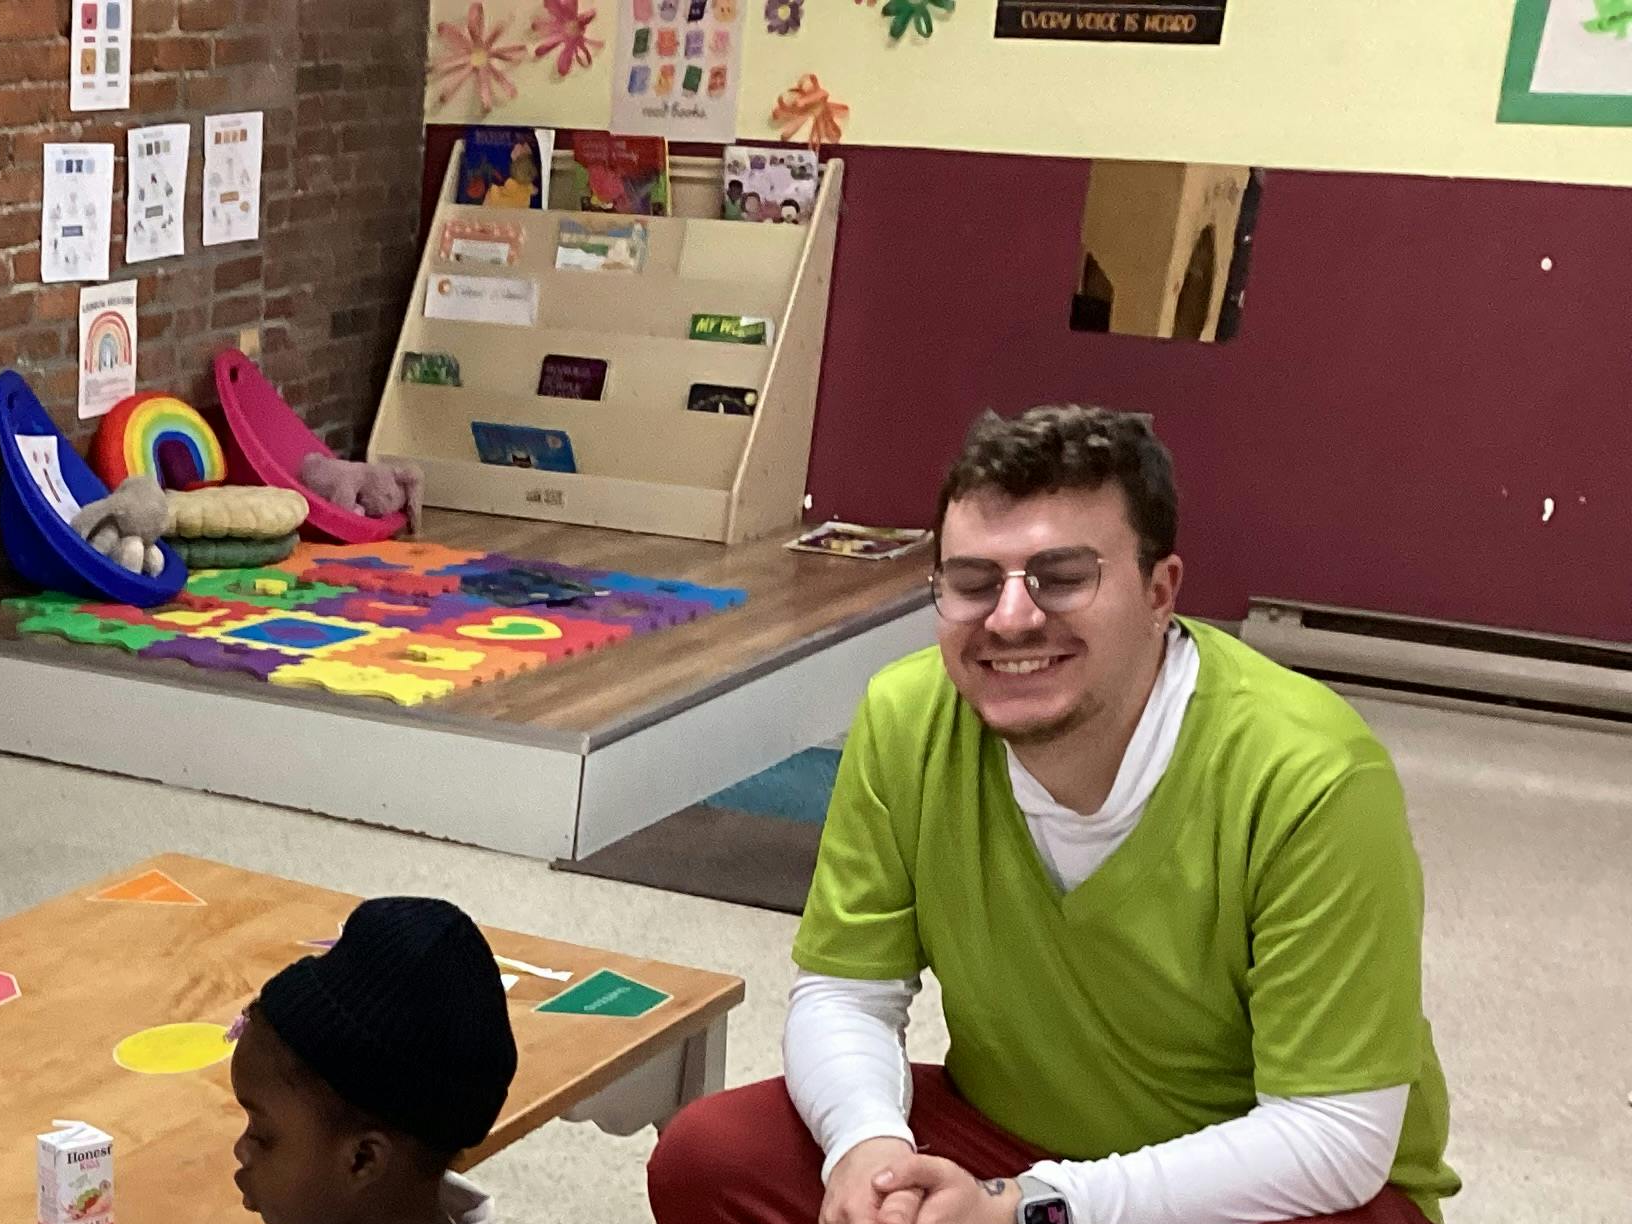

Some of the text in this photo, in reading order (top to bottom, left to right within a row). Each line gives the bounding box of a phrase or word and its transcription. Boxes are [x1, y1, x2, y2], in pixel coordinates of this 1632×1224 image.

[1021, 11, 1197, 33] EVERY VOICE IS HEARD
[67, 1144, 112, 1164] Honest
